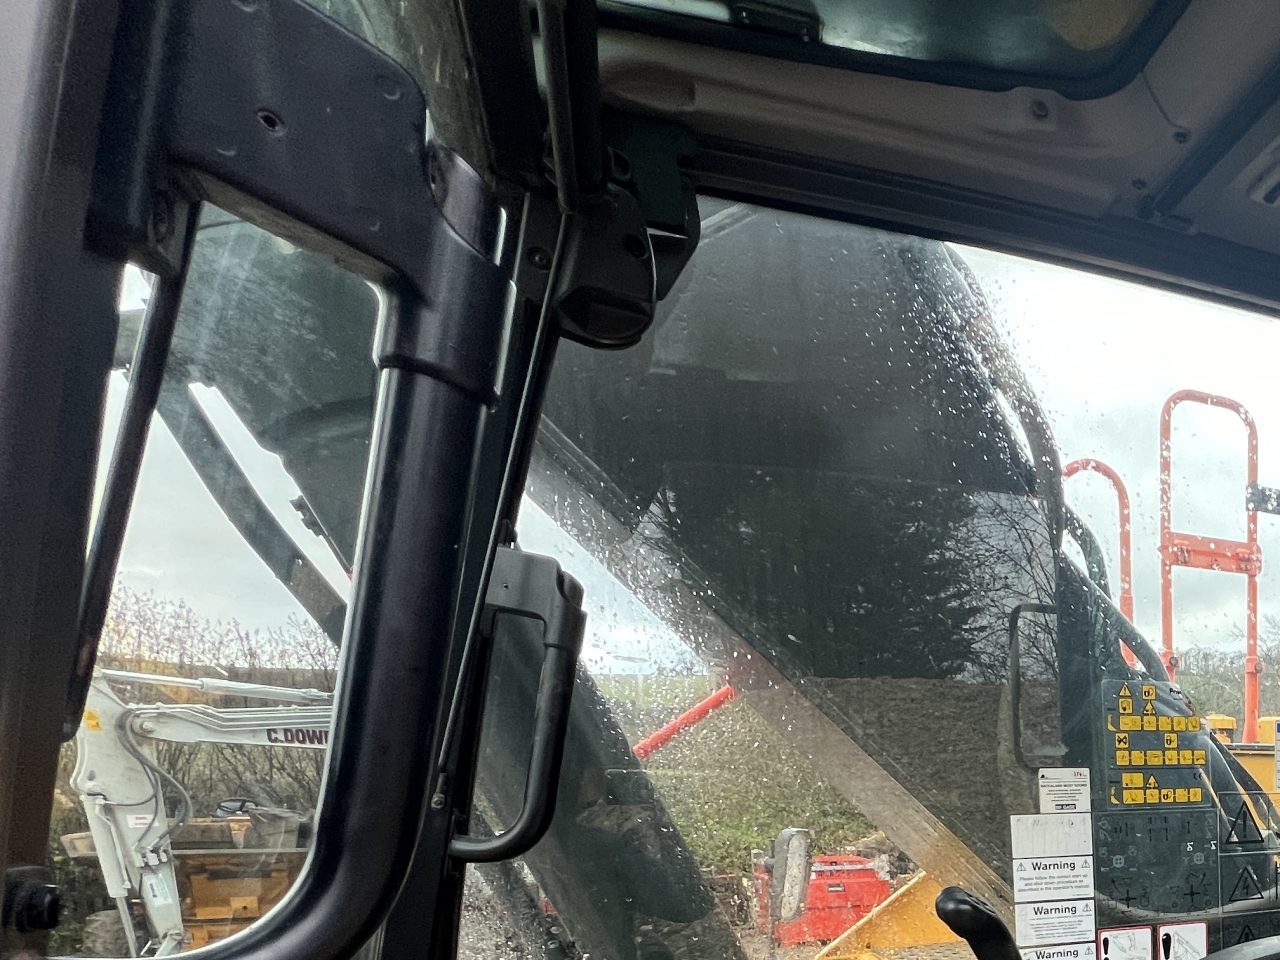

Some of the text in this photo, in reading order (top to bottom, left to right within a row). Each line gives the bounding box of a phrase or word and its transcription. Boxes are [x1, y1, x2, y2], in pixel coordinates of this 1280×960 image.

[1031, 861, 1076, 871] Warning
[1033, 905, 1077, 915] Warning
[1035, 949, 1079, 960] Warning
